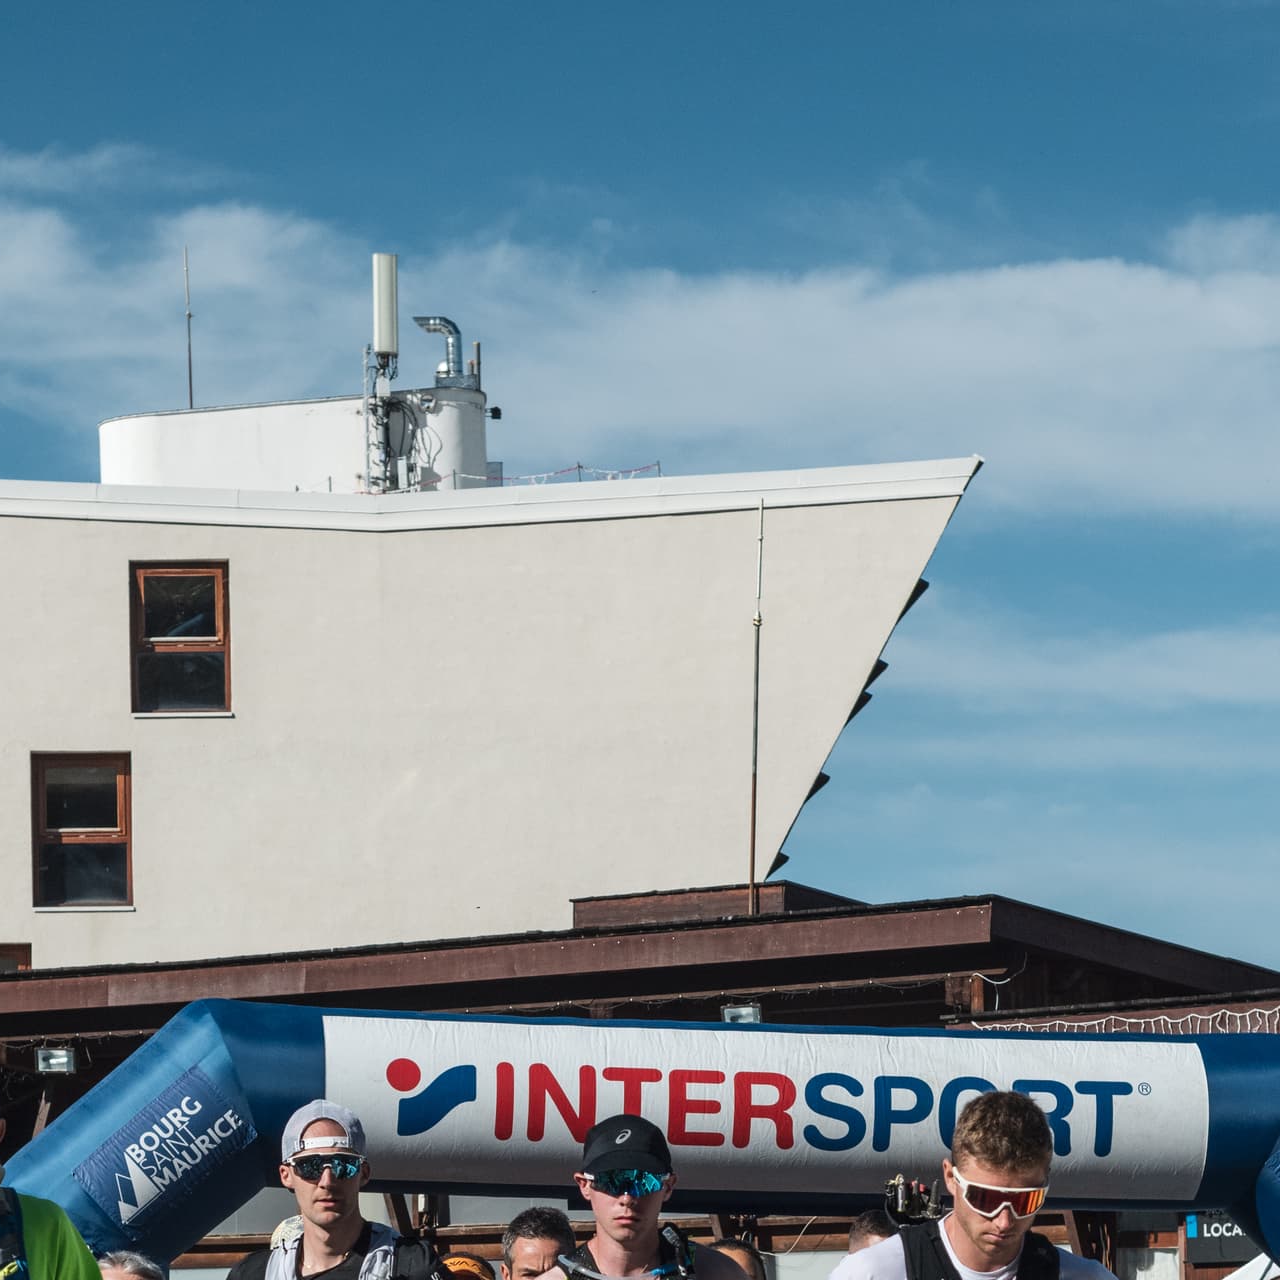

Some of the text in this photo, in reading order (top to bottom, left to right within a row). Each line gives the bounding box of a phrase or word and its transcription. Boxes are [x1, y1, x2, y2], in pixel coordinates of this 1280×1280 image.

[125, 1096, 203, 1164] BOURG
[139, 1121, 197, 1178] SAINT
[154, 1109, 243, 1192] MAURICE
[1203, 1223, 1246, 1237] LOCA
